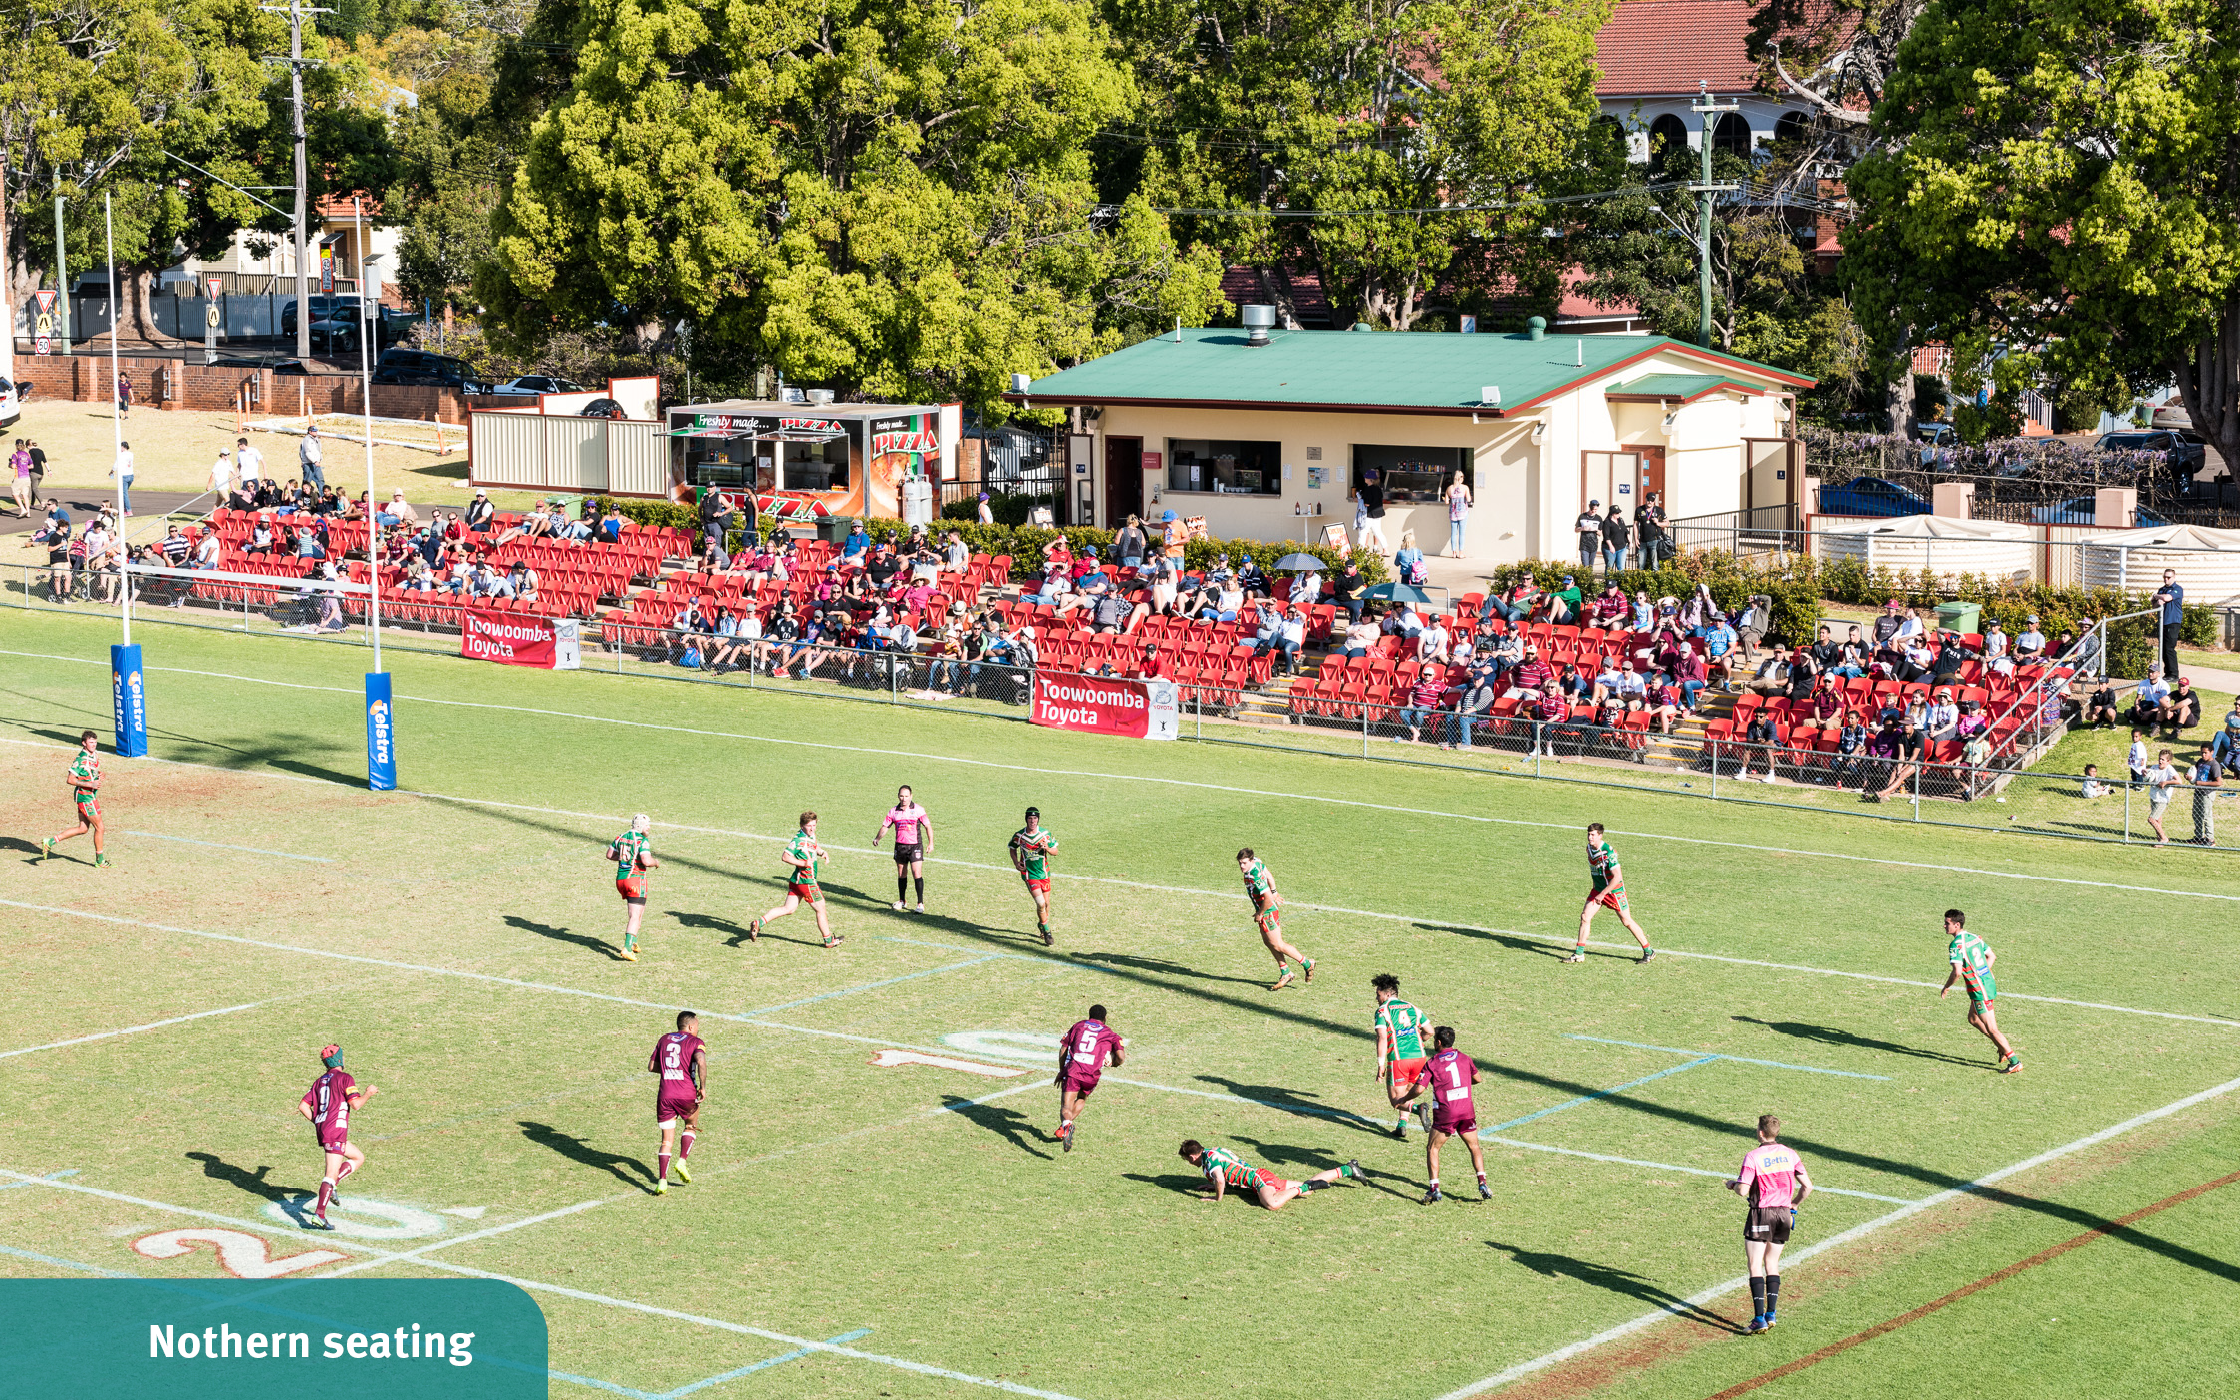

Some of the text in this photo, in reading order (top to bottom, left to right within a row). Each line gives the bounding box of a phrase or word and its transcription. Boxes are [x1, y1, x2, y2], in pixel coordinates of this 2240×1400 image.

[39, 341, 49, 350] 50
[699, 415, 731, 429] Freshly
[779, 417, 846, 432] PIZZA
[873, 430, 939, 460] PIZZA
[467, 615, 552, 642] Toowoomba
[467, 634, 514, 658] Toyota
[114, 674, 124, 733] Telstra
[131, 673, 144, 732] Telstra
[1040, 679, 1144, 709] Toowoomba
[1040, 700, 1097, 725] Toyota
[374, 702, 390, 764] Telstra
[1972, 946, 1984, 967] 2
[1398, 1010, 1412, 1029] 4
[1079, 1030, 1099, 1053] 5
[665, 1042, 681, 1069] 3
[1445, 1062, 1462, 1088] 1
[320, 1085, 330, 1112] 9
[1763, 1156, 1788, 1168] Betta
